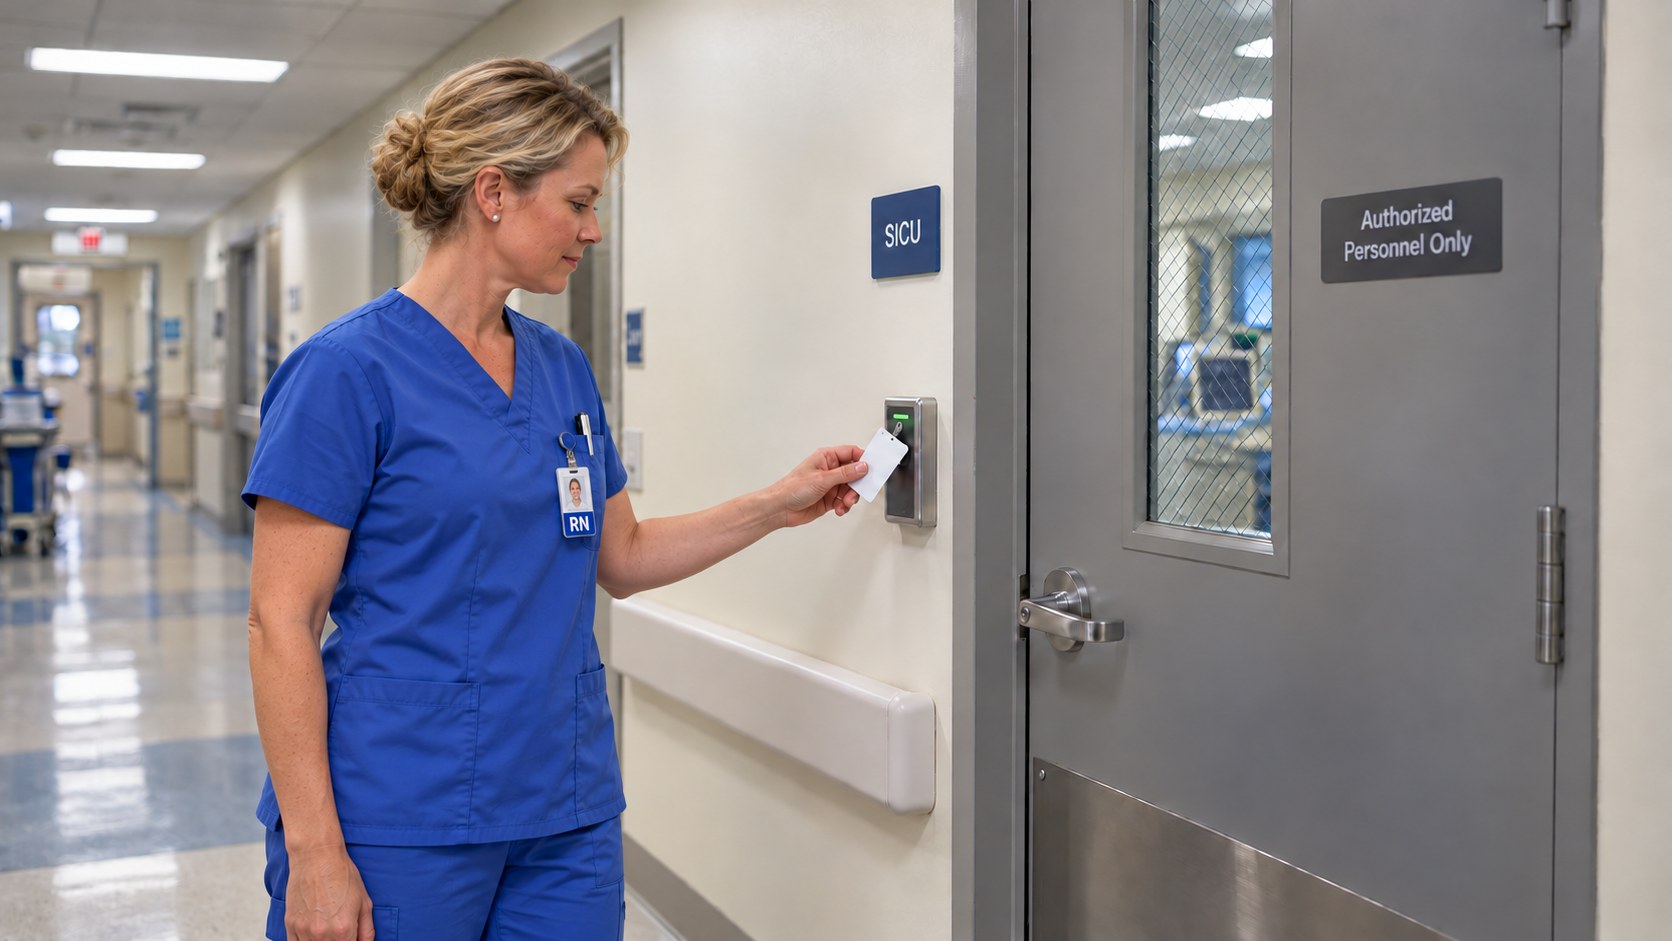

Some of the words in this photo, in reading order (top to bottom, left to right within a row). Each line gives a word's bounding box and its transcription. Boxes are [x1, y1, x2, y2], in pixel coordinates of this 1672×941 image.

[1360, 199, 1453, 231] Authorized
[884, 218, 921, 248] SICU
[1344, 233, 1424, 262] Personnel
[1429, 229, 1472, 257] Only
[569, 515, 590, 533] RN
